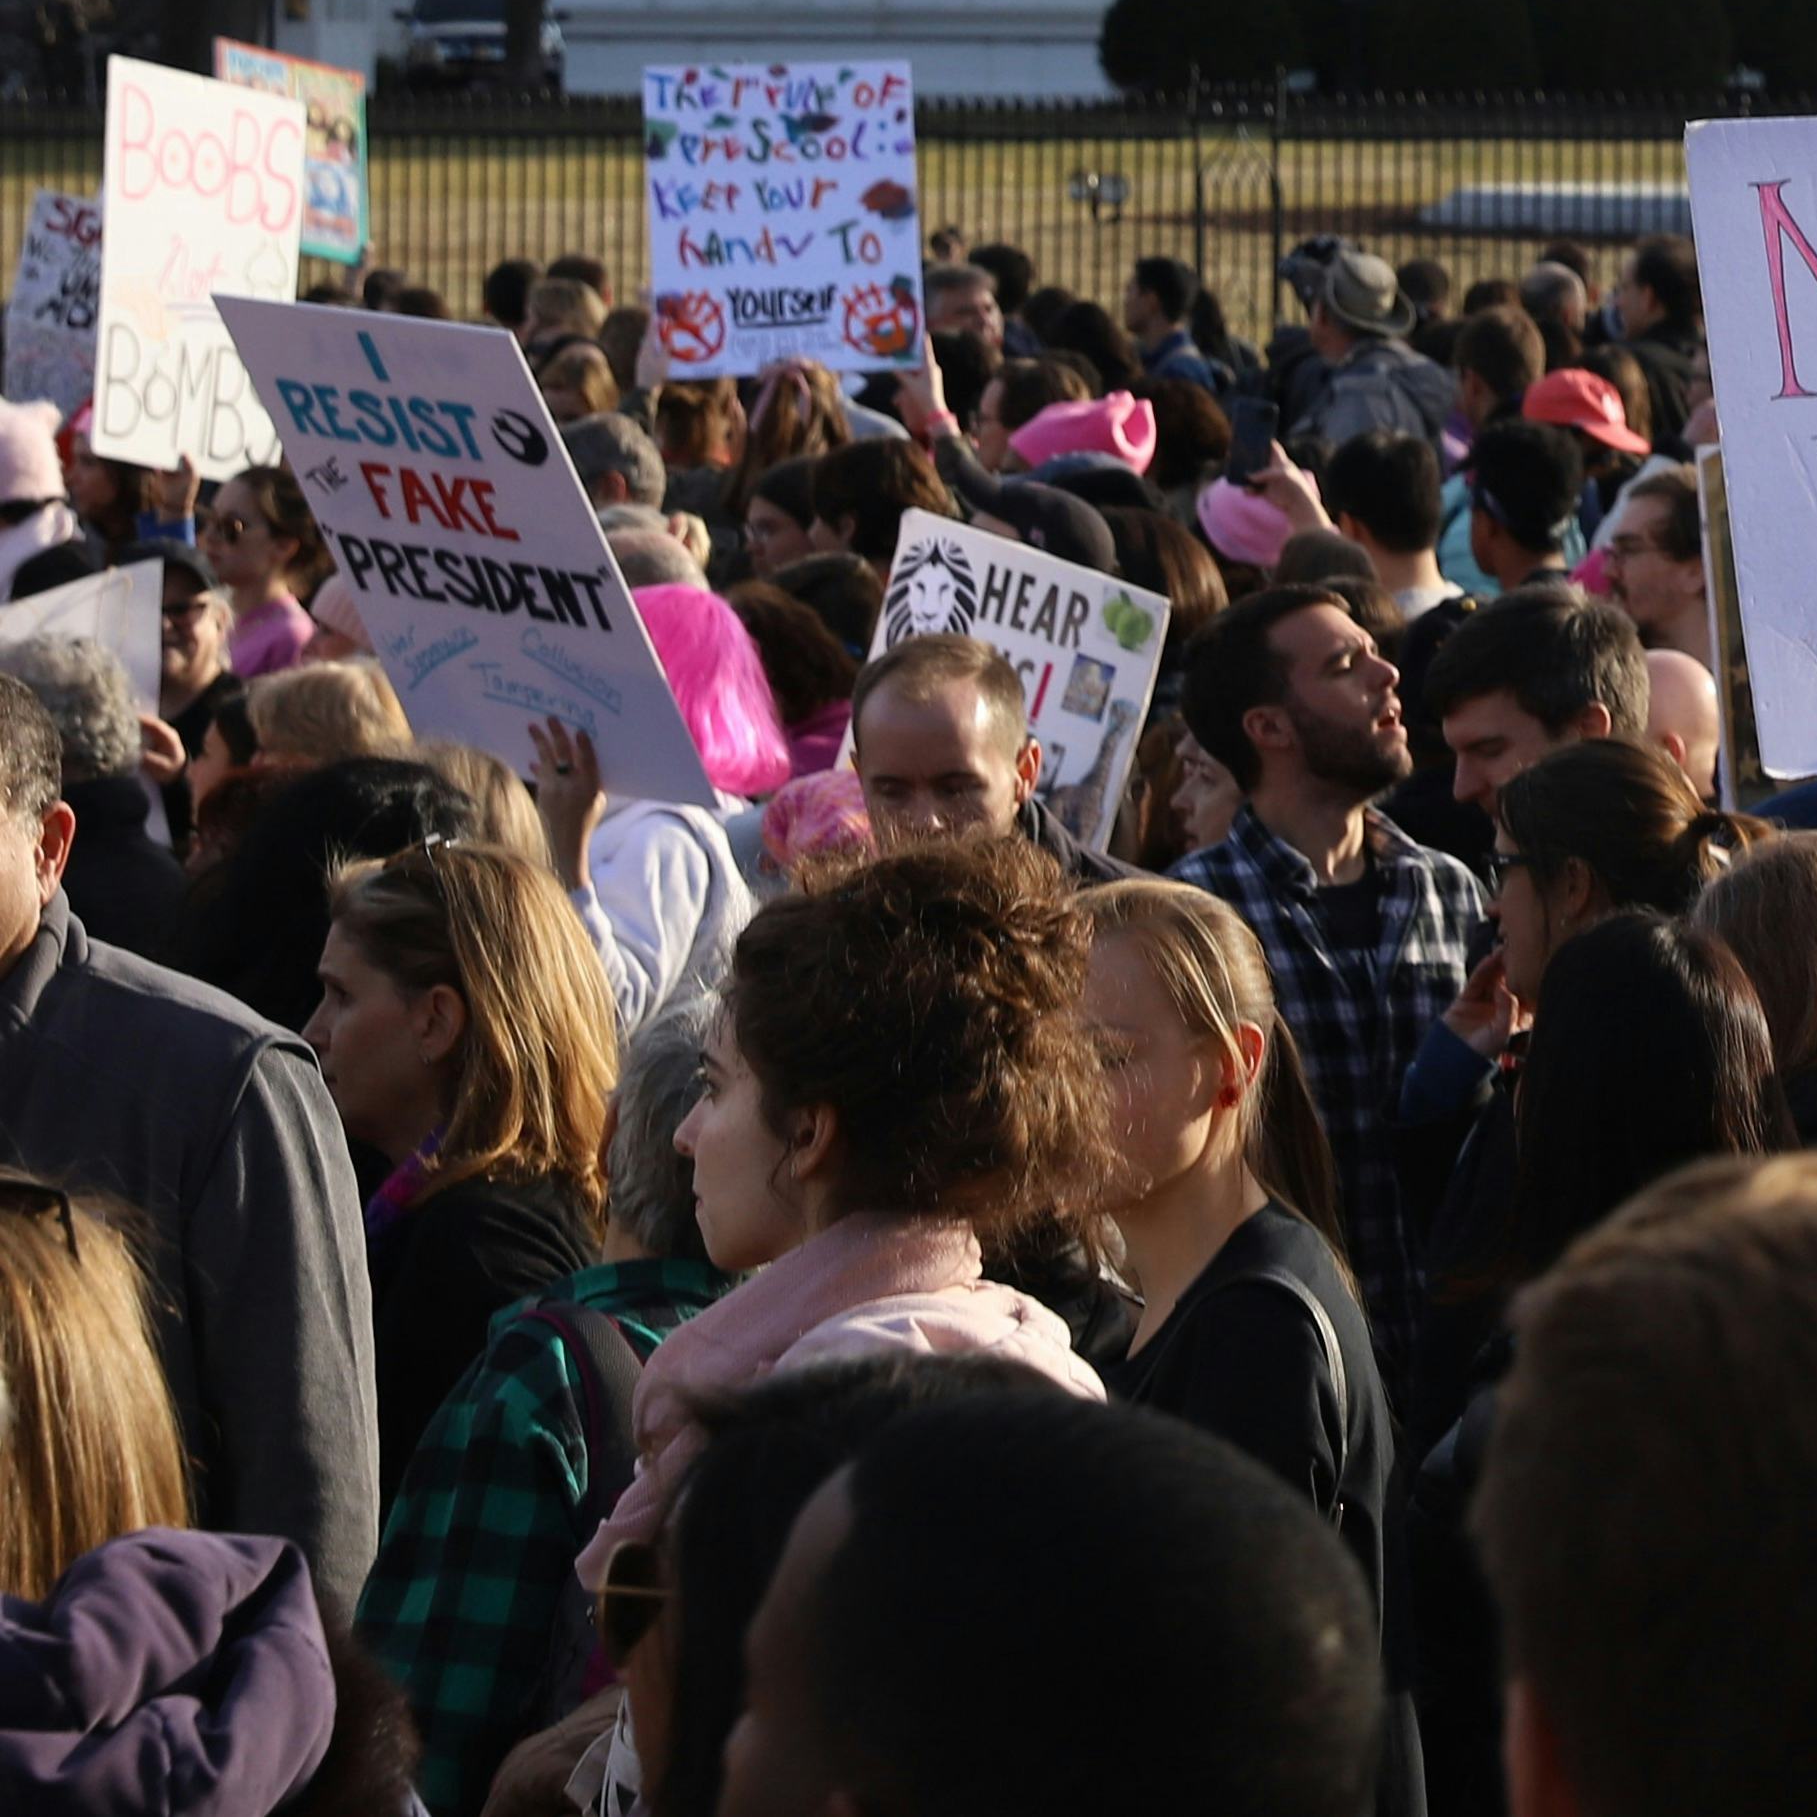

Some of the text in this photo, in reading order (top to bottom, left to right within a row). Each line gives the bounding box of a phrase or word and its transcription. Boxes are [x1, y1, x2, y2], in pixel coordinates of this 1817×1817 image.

[356, 330, 391, 383] I
[275, 376, 485, 463] RESIST
[304, 454, 523, 543] THE FAKE
[321, 522, 615, 634] "PRESIDENT"
[978, 561, 1091, 651] HEAR
